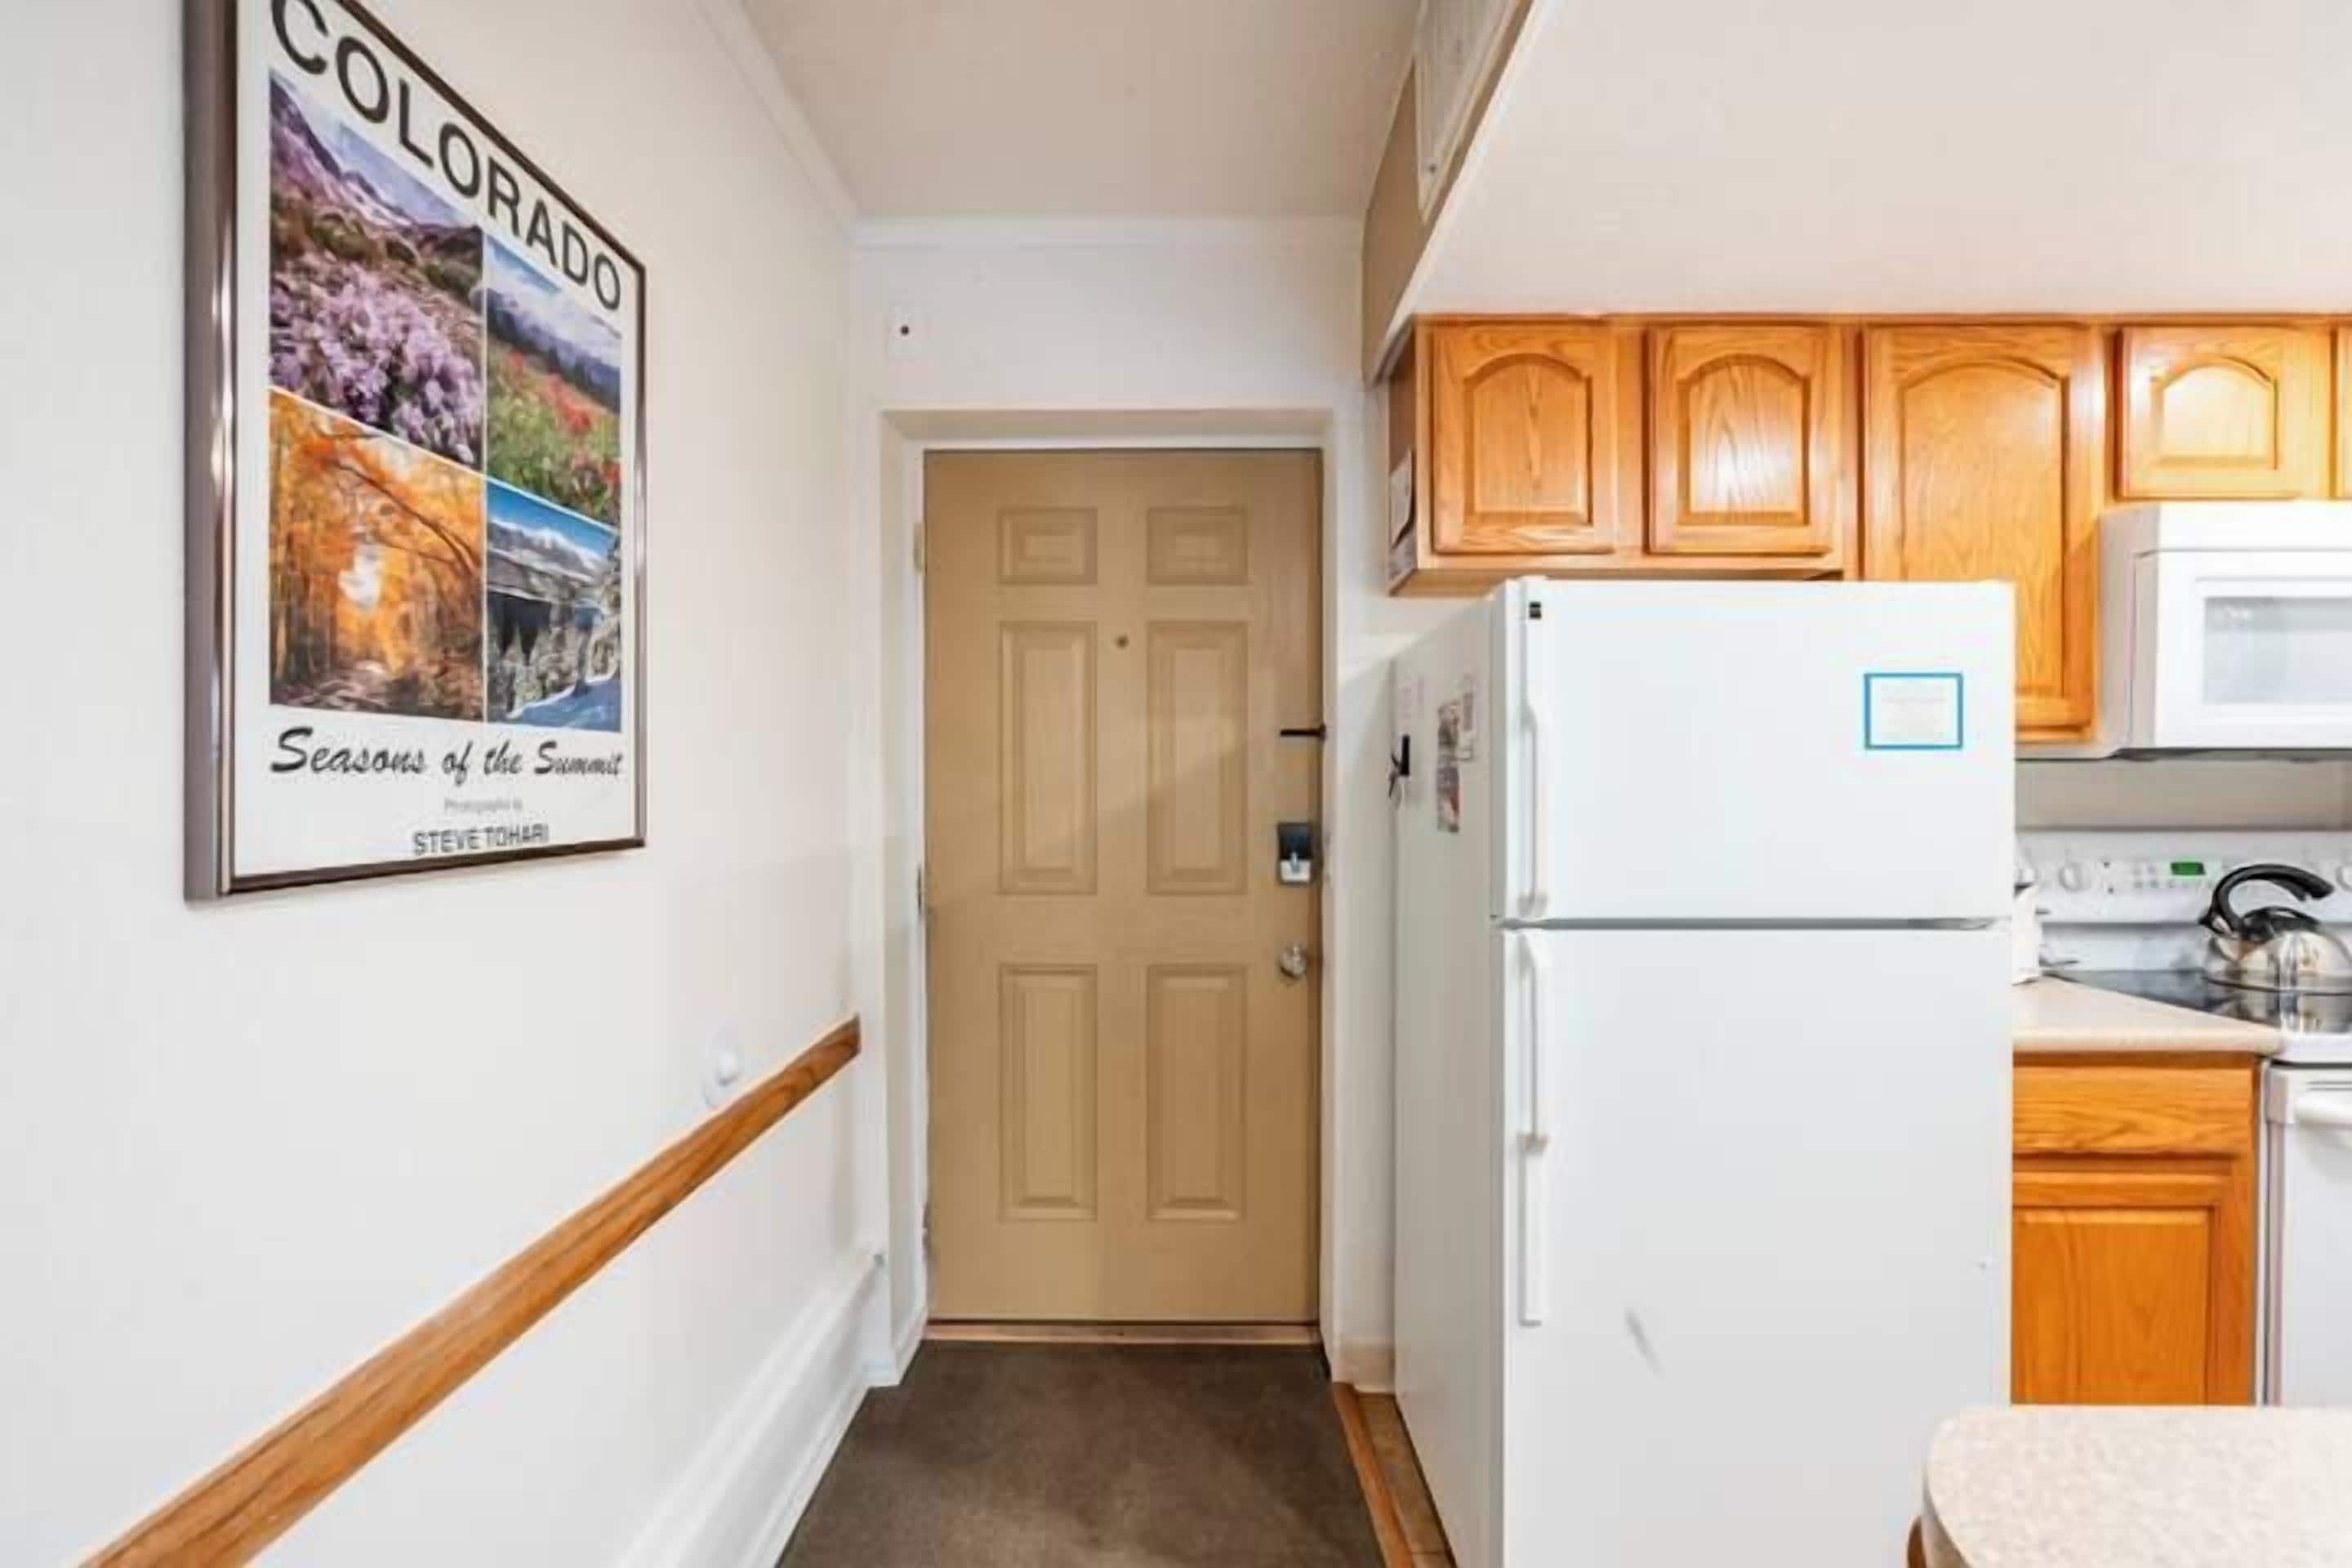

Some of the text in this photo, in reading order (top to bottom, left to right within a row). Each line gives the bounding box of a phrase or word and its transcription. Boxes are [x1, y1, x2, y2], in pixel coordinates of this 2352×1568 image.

[271, 0, 621, 311] COLORADO
[270, 726, 622, 786] Seasons of the Summit
[414, 830, 480, 854] STEVE
